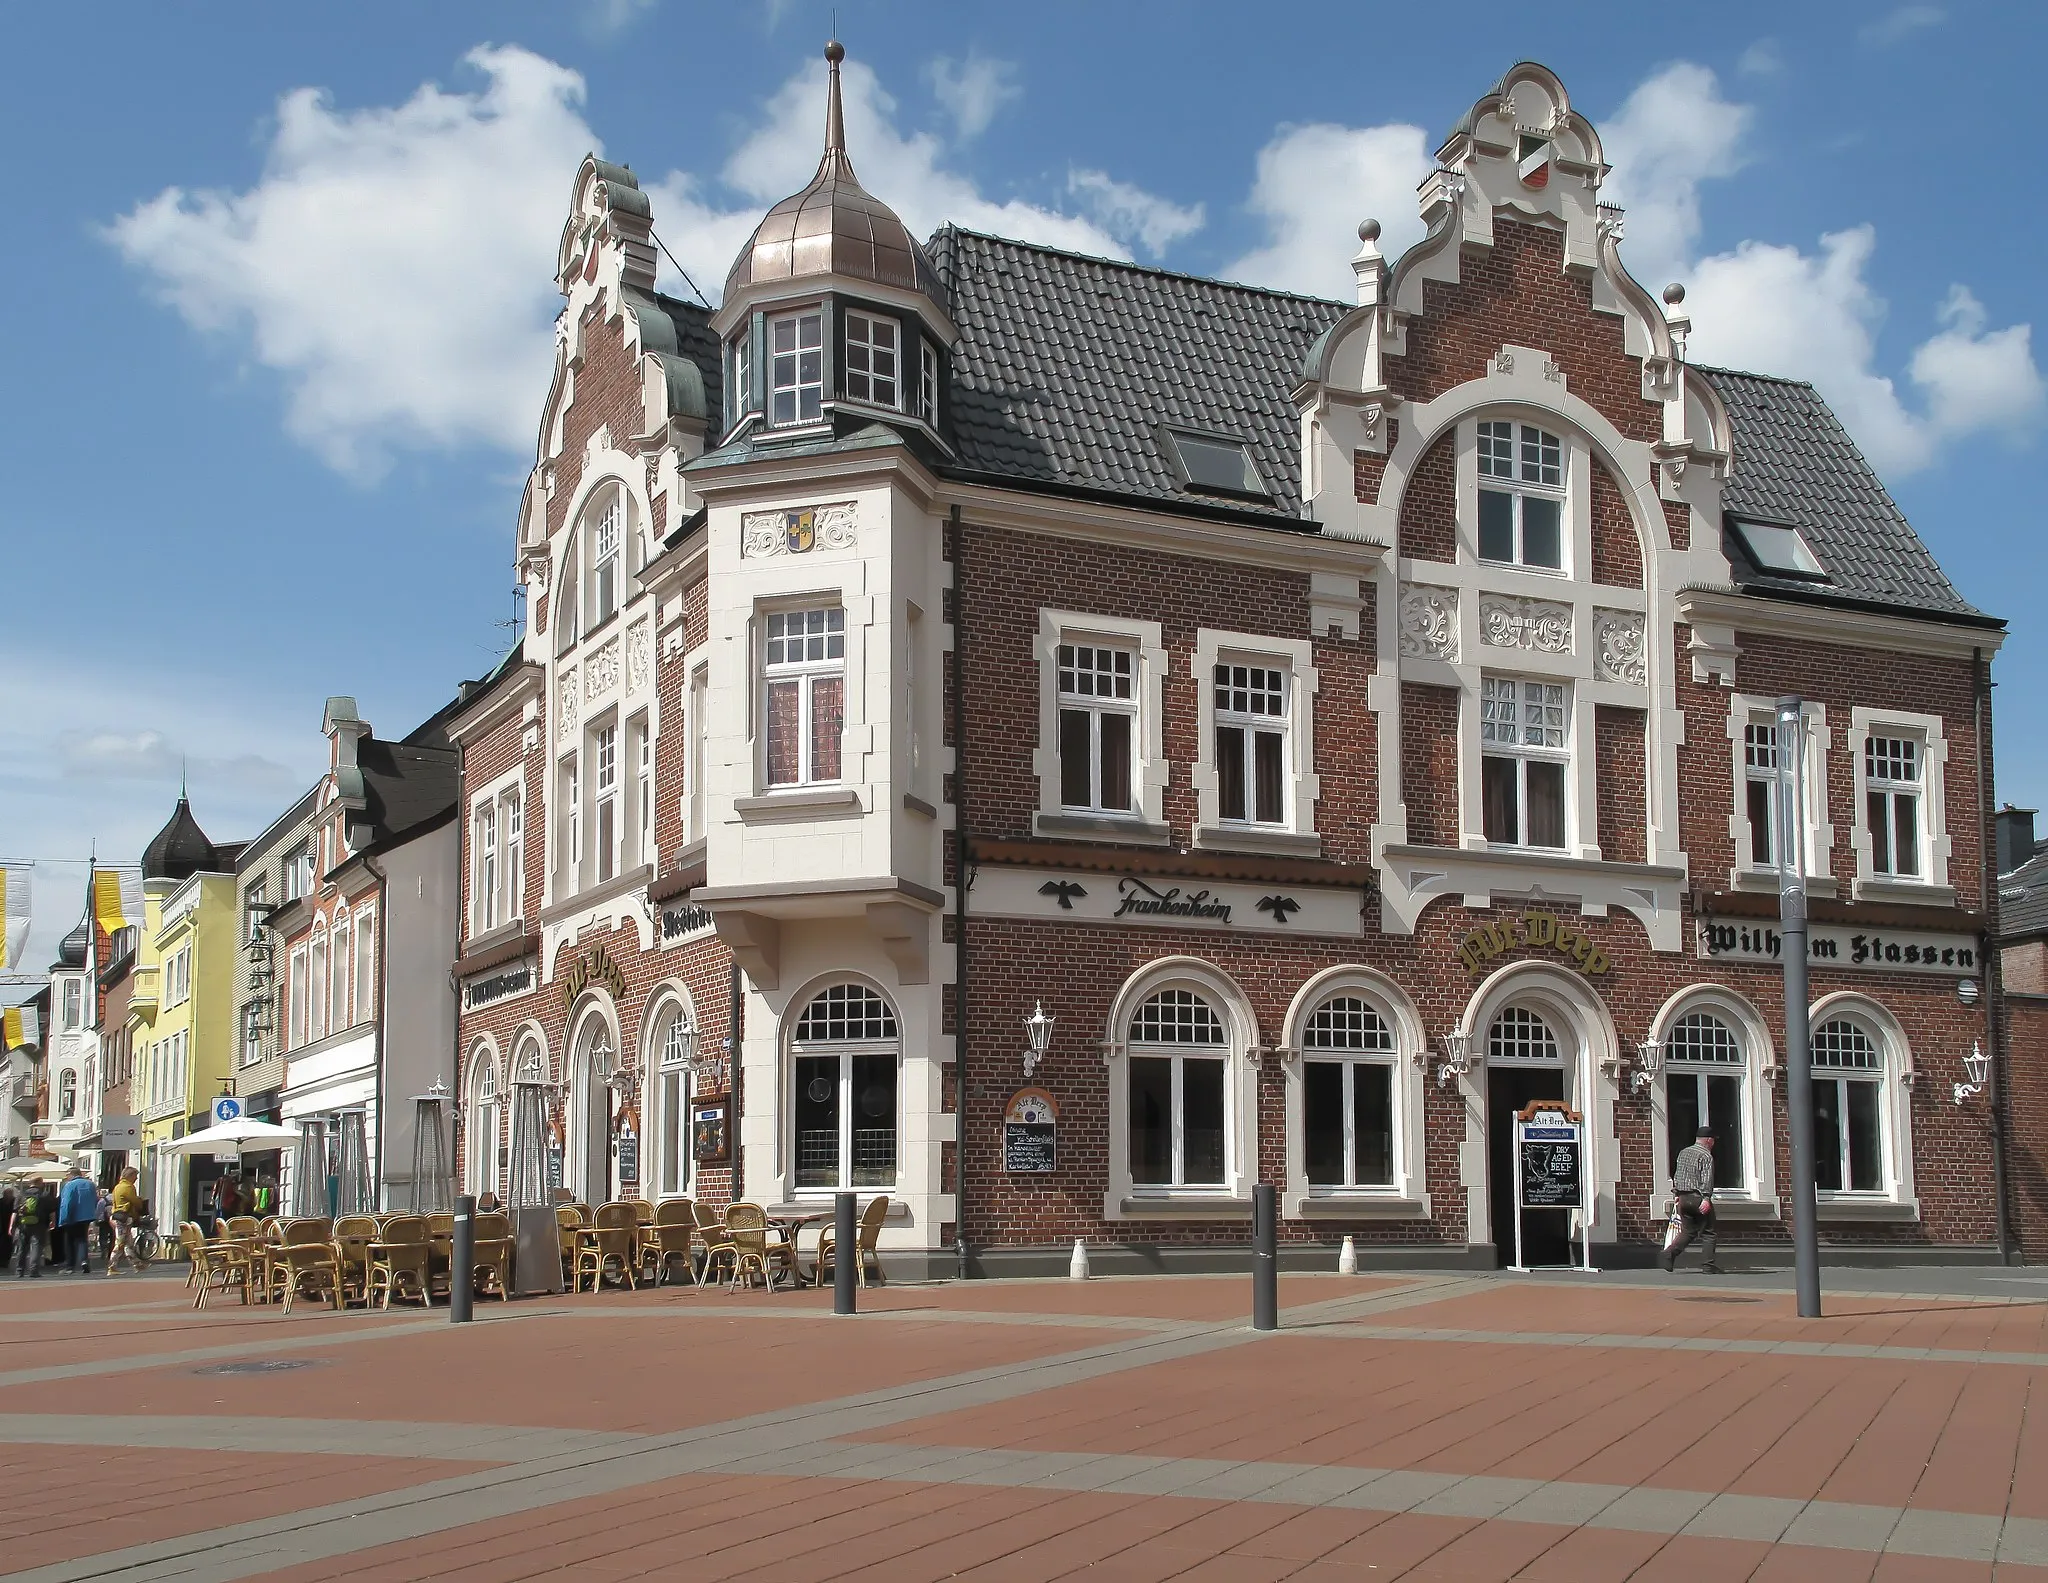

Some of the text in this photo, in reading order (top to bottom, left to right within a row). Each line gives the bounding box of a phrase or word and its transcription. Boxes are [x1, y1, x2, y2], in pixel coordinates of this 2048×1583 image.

[1114, 877, 1232, 924] Frankenheim
[1457, 920, 1518, 978] Alt
[1702, 924, 1974, 968] Wilhm Stassen
[1551, 1153, 1573, 1162] AGED
[1555, 1145, 1570, 1154] DRY
[1550, 1162, 1573, 1171] BEEF
